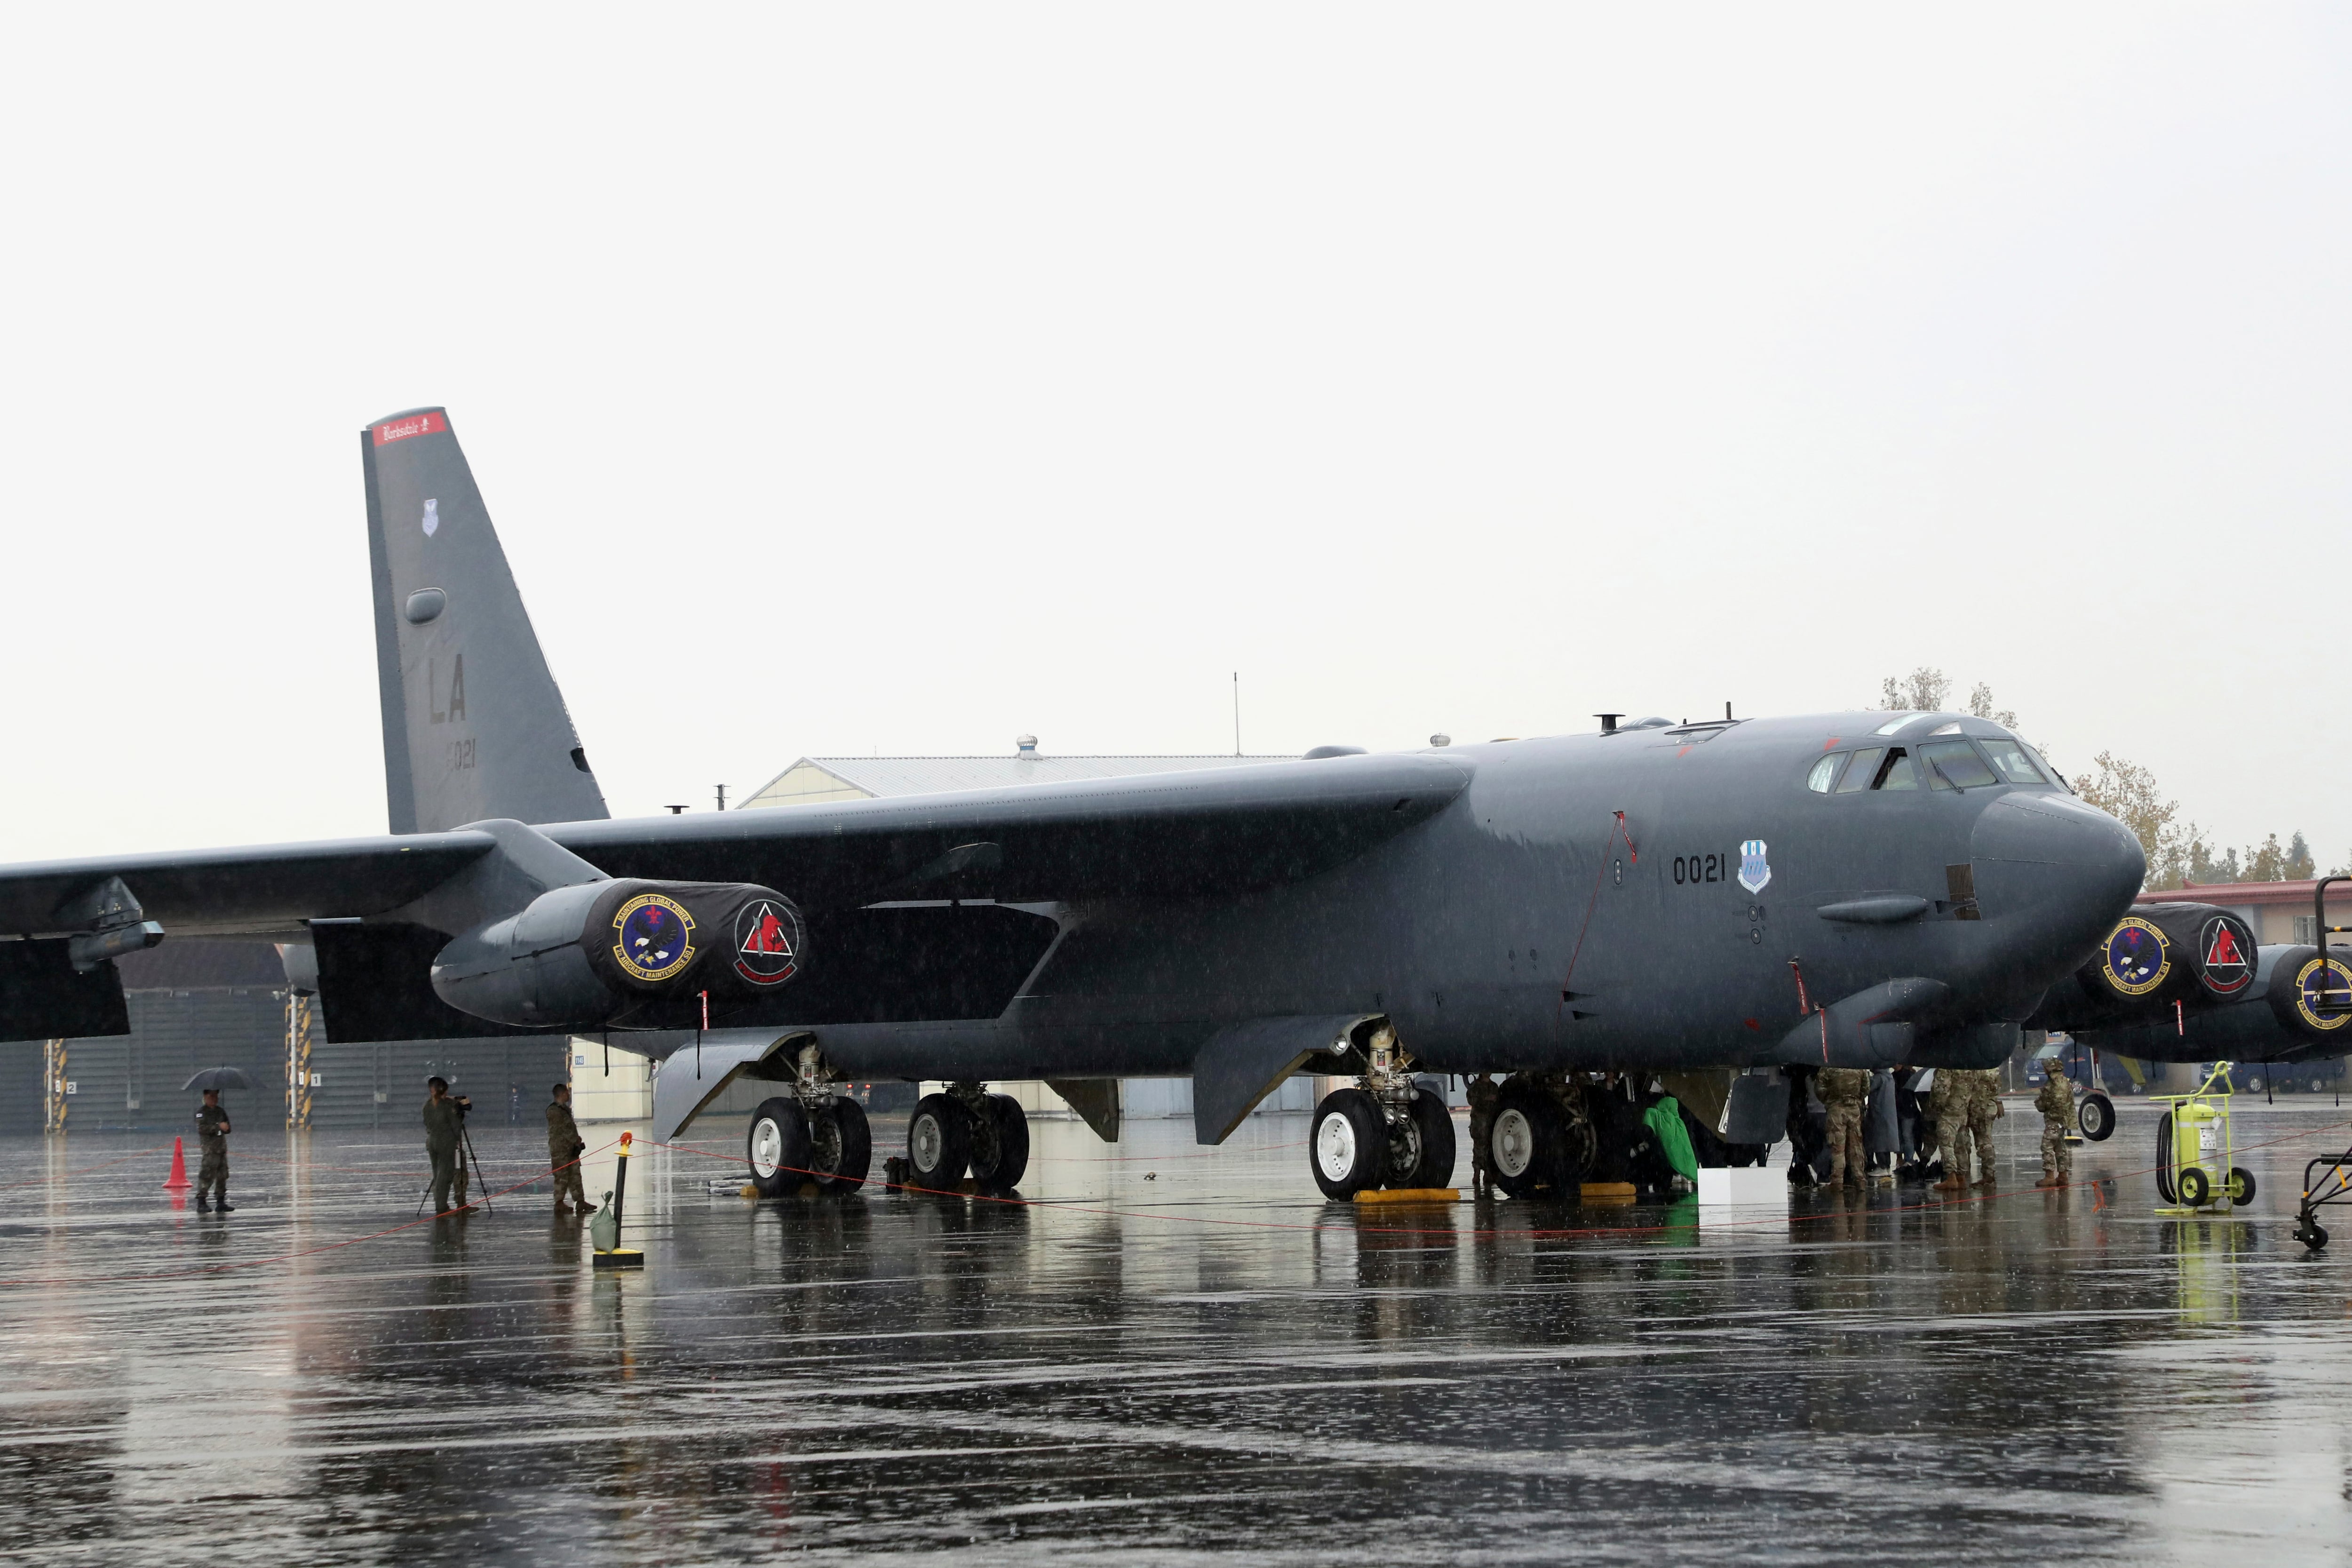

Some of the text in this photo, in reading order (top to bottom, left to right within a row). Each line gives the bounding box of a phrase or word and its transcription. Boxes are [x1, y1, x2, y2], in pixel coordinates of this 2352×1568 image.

[429, 654, 466, 724] LA
[1674, 853, 1726, 884] 0021
[618, 897, 689, 922] MAINTAINING GLOBAL POWER
[2129, 920, 2147, 928] GLOBAL
[2148, 925, 2163, 941] POWER
[620, 956, 645, 977] AIRCRAFT
[646, 958, 686, 979] MAINTENANCE
[683, 950, 691, 959] SQ
[2299, 962, 2319, 981] MAINTAININ
[2110, 974, 2131, 992] AIRCRAFT
[2131, 975, 2163, 993] MAINTENANCE
[2161, 965, 2168, 975] SQ
[2303, 1009, 2321, 1026] AIRCRAFT
[2321, 1014, 2350, 1027] MAINTENANC
